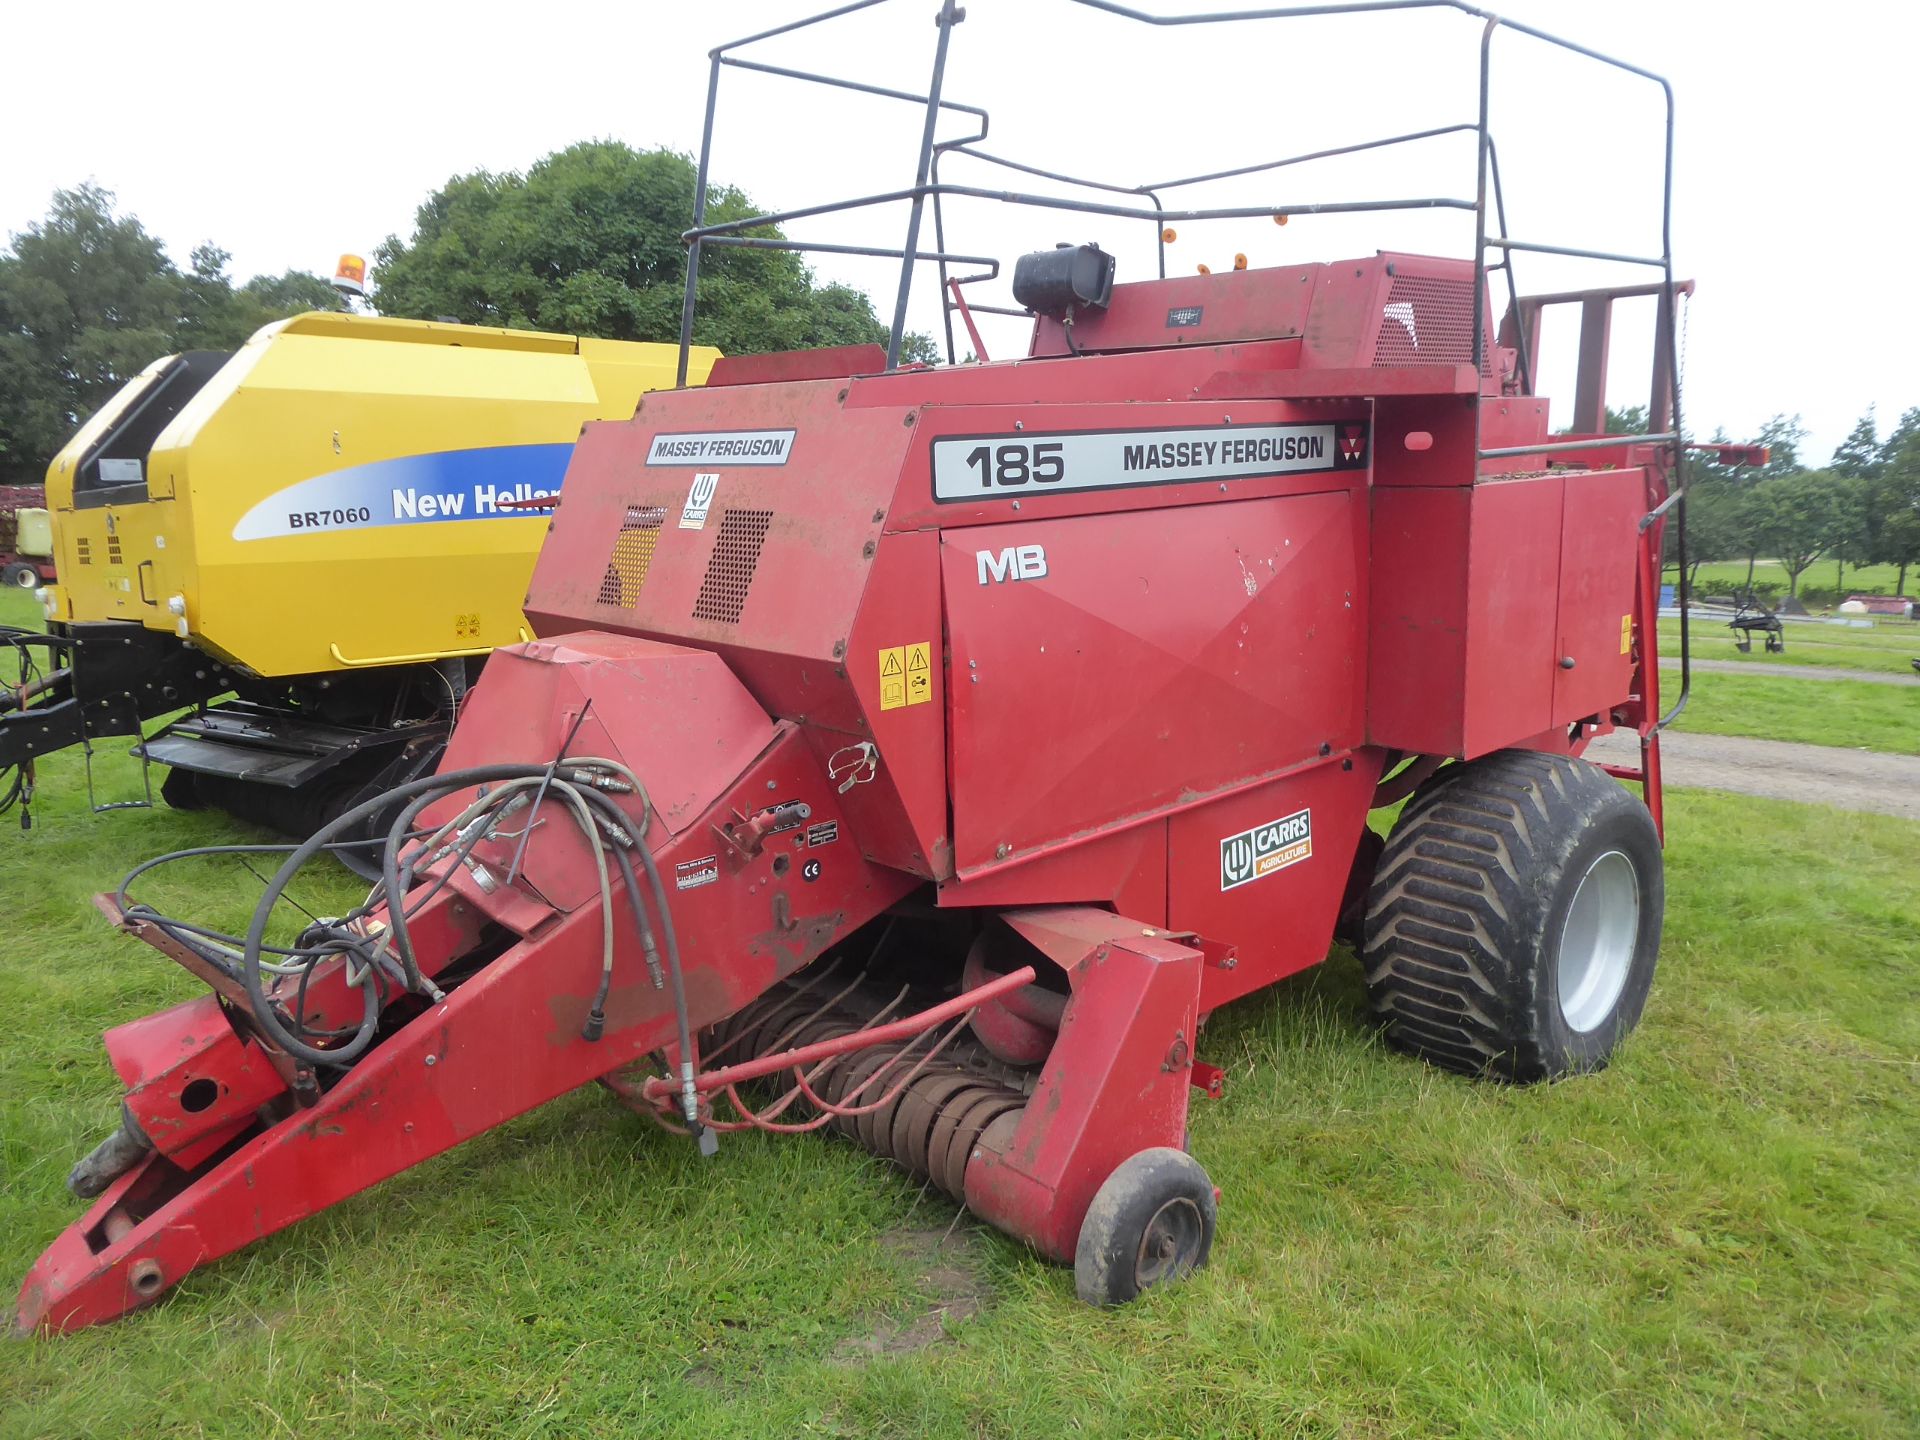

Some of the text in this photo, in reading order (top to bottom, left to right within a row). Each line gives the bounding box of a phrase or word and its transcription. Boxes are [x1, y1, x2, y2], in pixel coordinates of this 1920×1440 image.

[654, 439, 786, 457] MASSEY FERGUSON
[966, 436, 1324, 487] 185 MASSEY FERGUSON
[288, 507, 370, 529] BR7060
[392, 487, 465, 519] New
[976, 544, 1048, 585] MB
[1257, 814, 1308, 852] CARRS
[1259, 844, 1307, 872] AGRICULTURE
